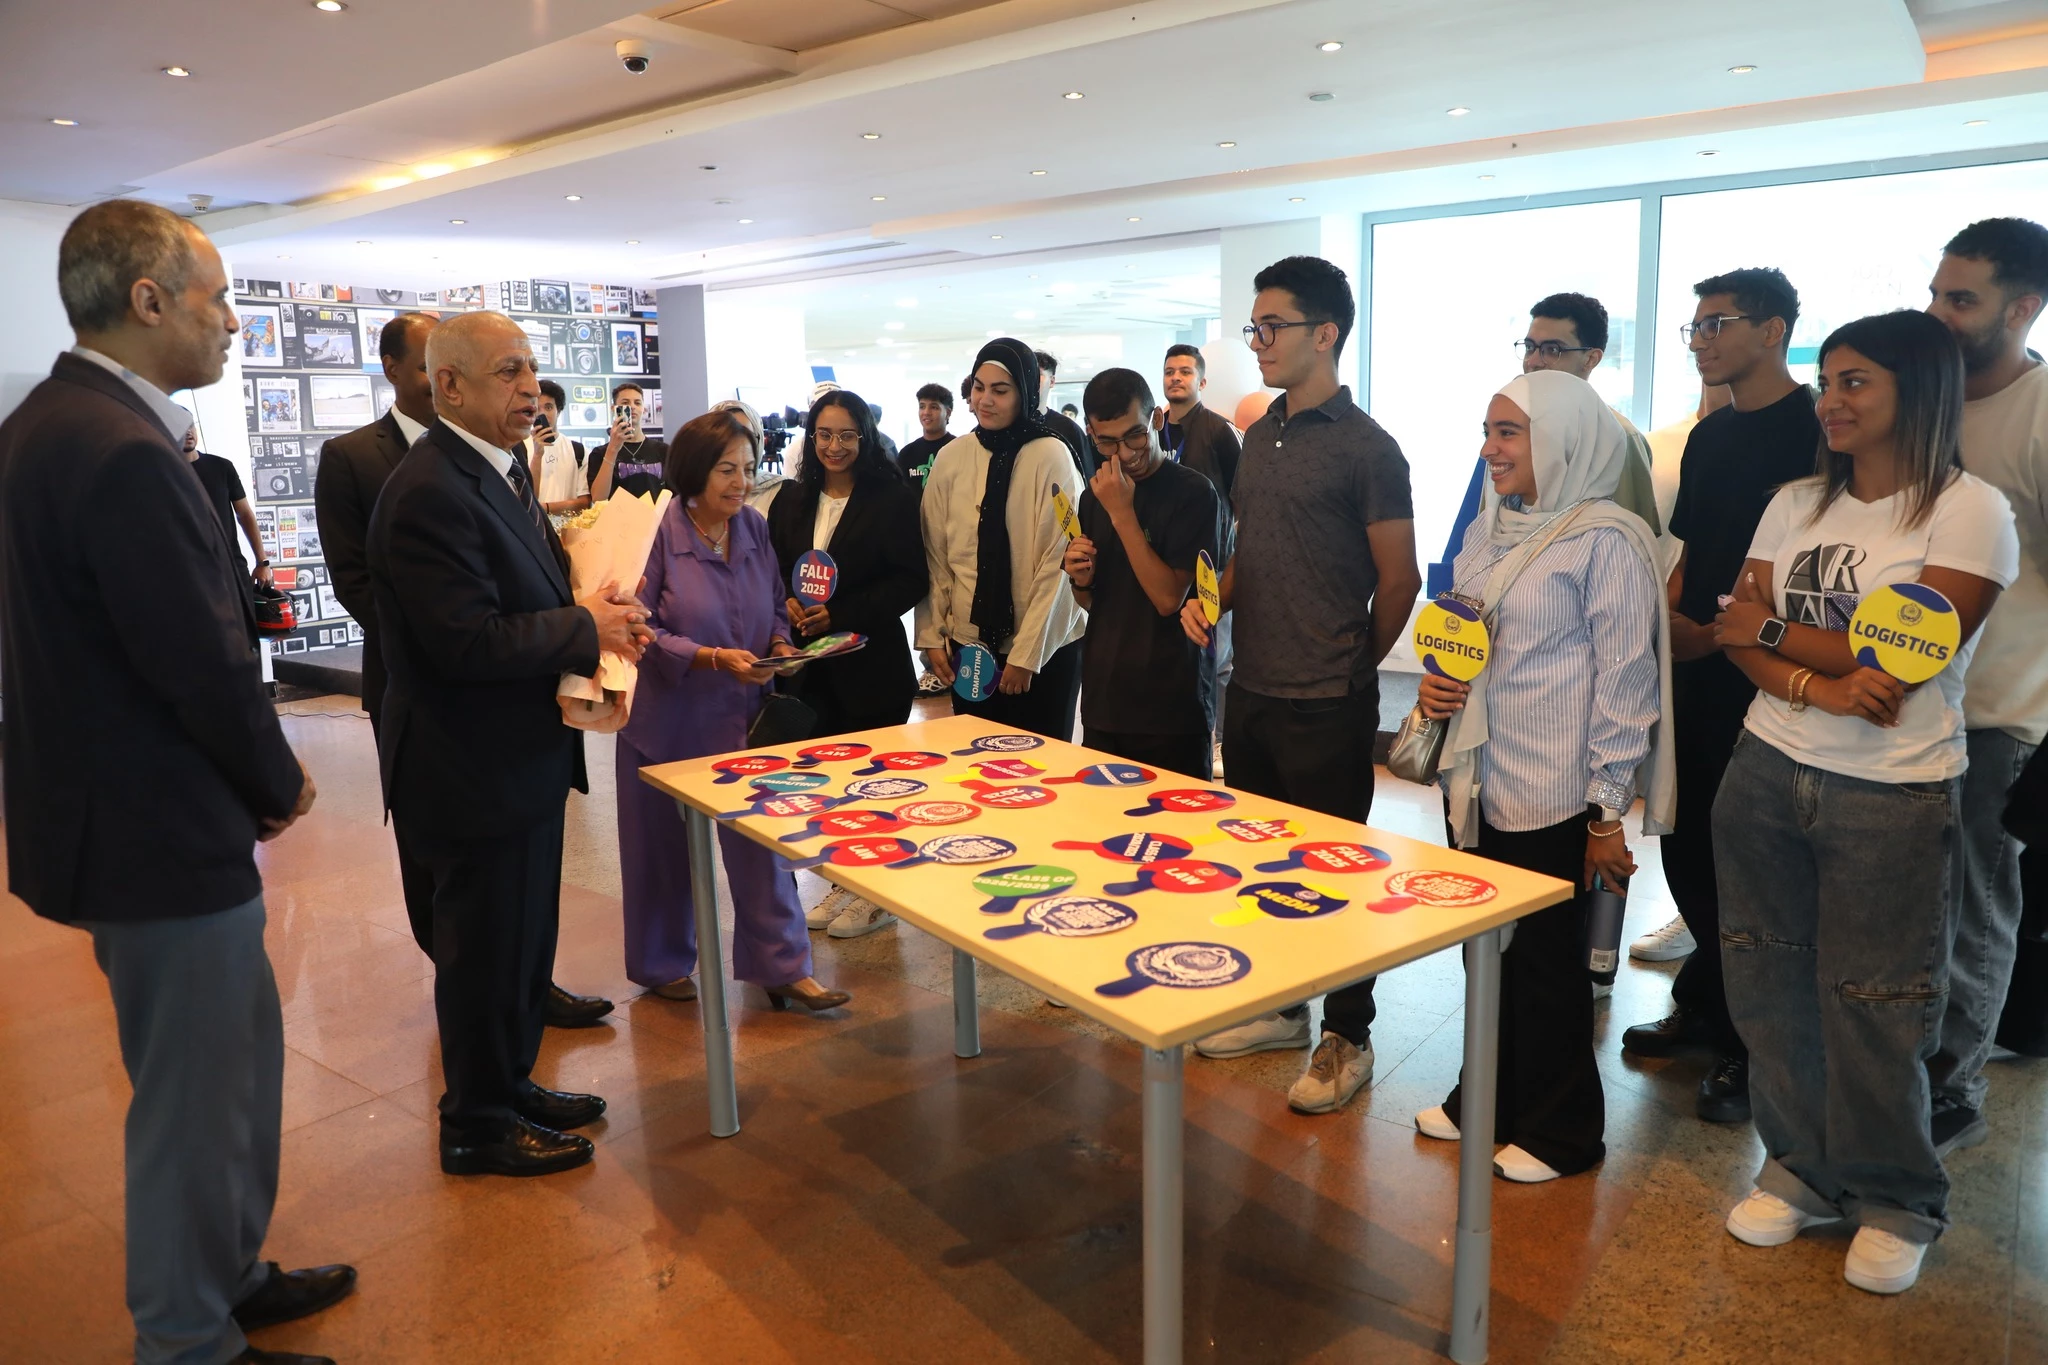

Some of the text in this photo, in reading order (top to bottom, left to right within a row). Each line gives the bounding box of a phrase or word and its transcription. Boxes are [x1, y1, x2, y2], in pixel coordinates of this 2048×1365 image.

[799, 563, 831, 581] FALL
[800, 582, 826, 596] 2025
[1416, 632, 1484, 661] LOGISTICS
[1853, 619, 1949, 661] LOGISTICS
[971, 650, 982, 699] COMPUTING
[888, 756, 925, 767] LAW
[754, 778, 822, 788] COMPUTING
[981, 788, 1025, 799] 2025
[990, 791, 1047, 804] FALL
[1169, 795, 1207, 808] LAW
[764, 800, 795, 815] 2025
[784, 795, 823, 812] FALL
[829, 817, 867, 830] LAW
[1239, 818, 1293, 838] FALL
[1221, 824, 1265, 841] 2025
[848, 844, 880, 860] LAW
[1308, 849, 1352, 868] 2025
[1330, 845, 1376, 866] FALL
[1002, 873, 1076, 883] CLASS OF
[1164, 867, 1207, 886] LAW
[1253, 887, 1321, 914] MEDIA
